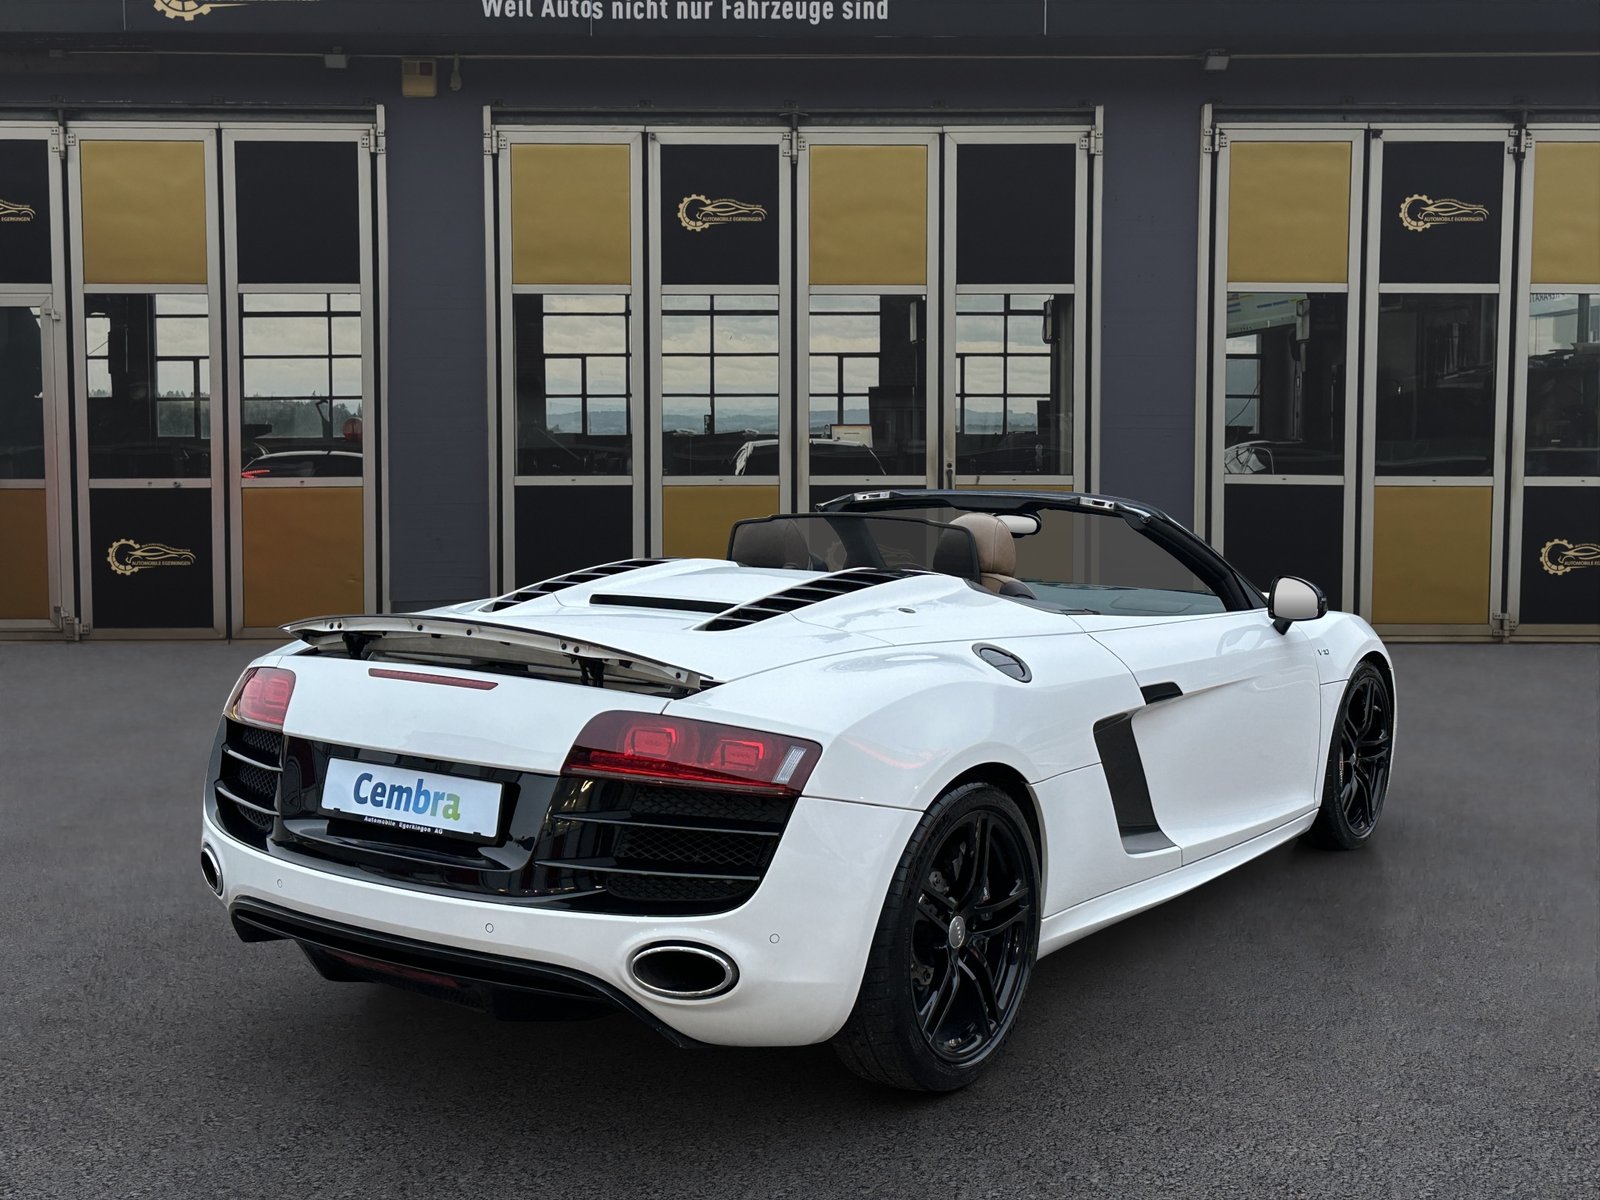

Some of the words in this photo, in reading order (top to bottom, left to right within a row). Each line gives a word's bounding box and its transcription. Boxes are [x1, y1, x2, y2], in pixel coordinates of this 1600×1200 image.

[482, 0, 533, 18] Weil
[541, 0, 604, 19] Autos
[611, 0, 668, 19] nicht
[676, 0, 713, 19] nur
[722, 0, 834, 25] Fahrzeuge
[842, 0, 889, 19] sind
[353, 772, 461, 821] Cembra
[363, 815, 396, 827] Automobile
[398, 821, 431, 833] Egerkingen
